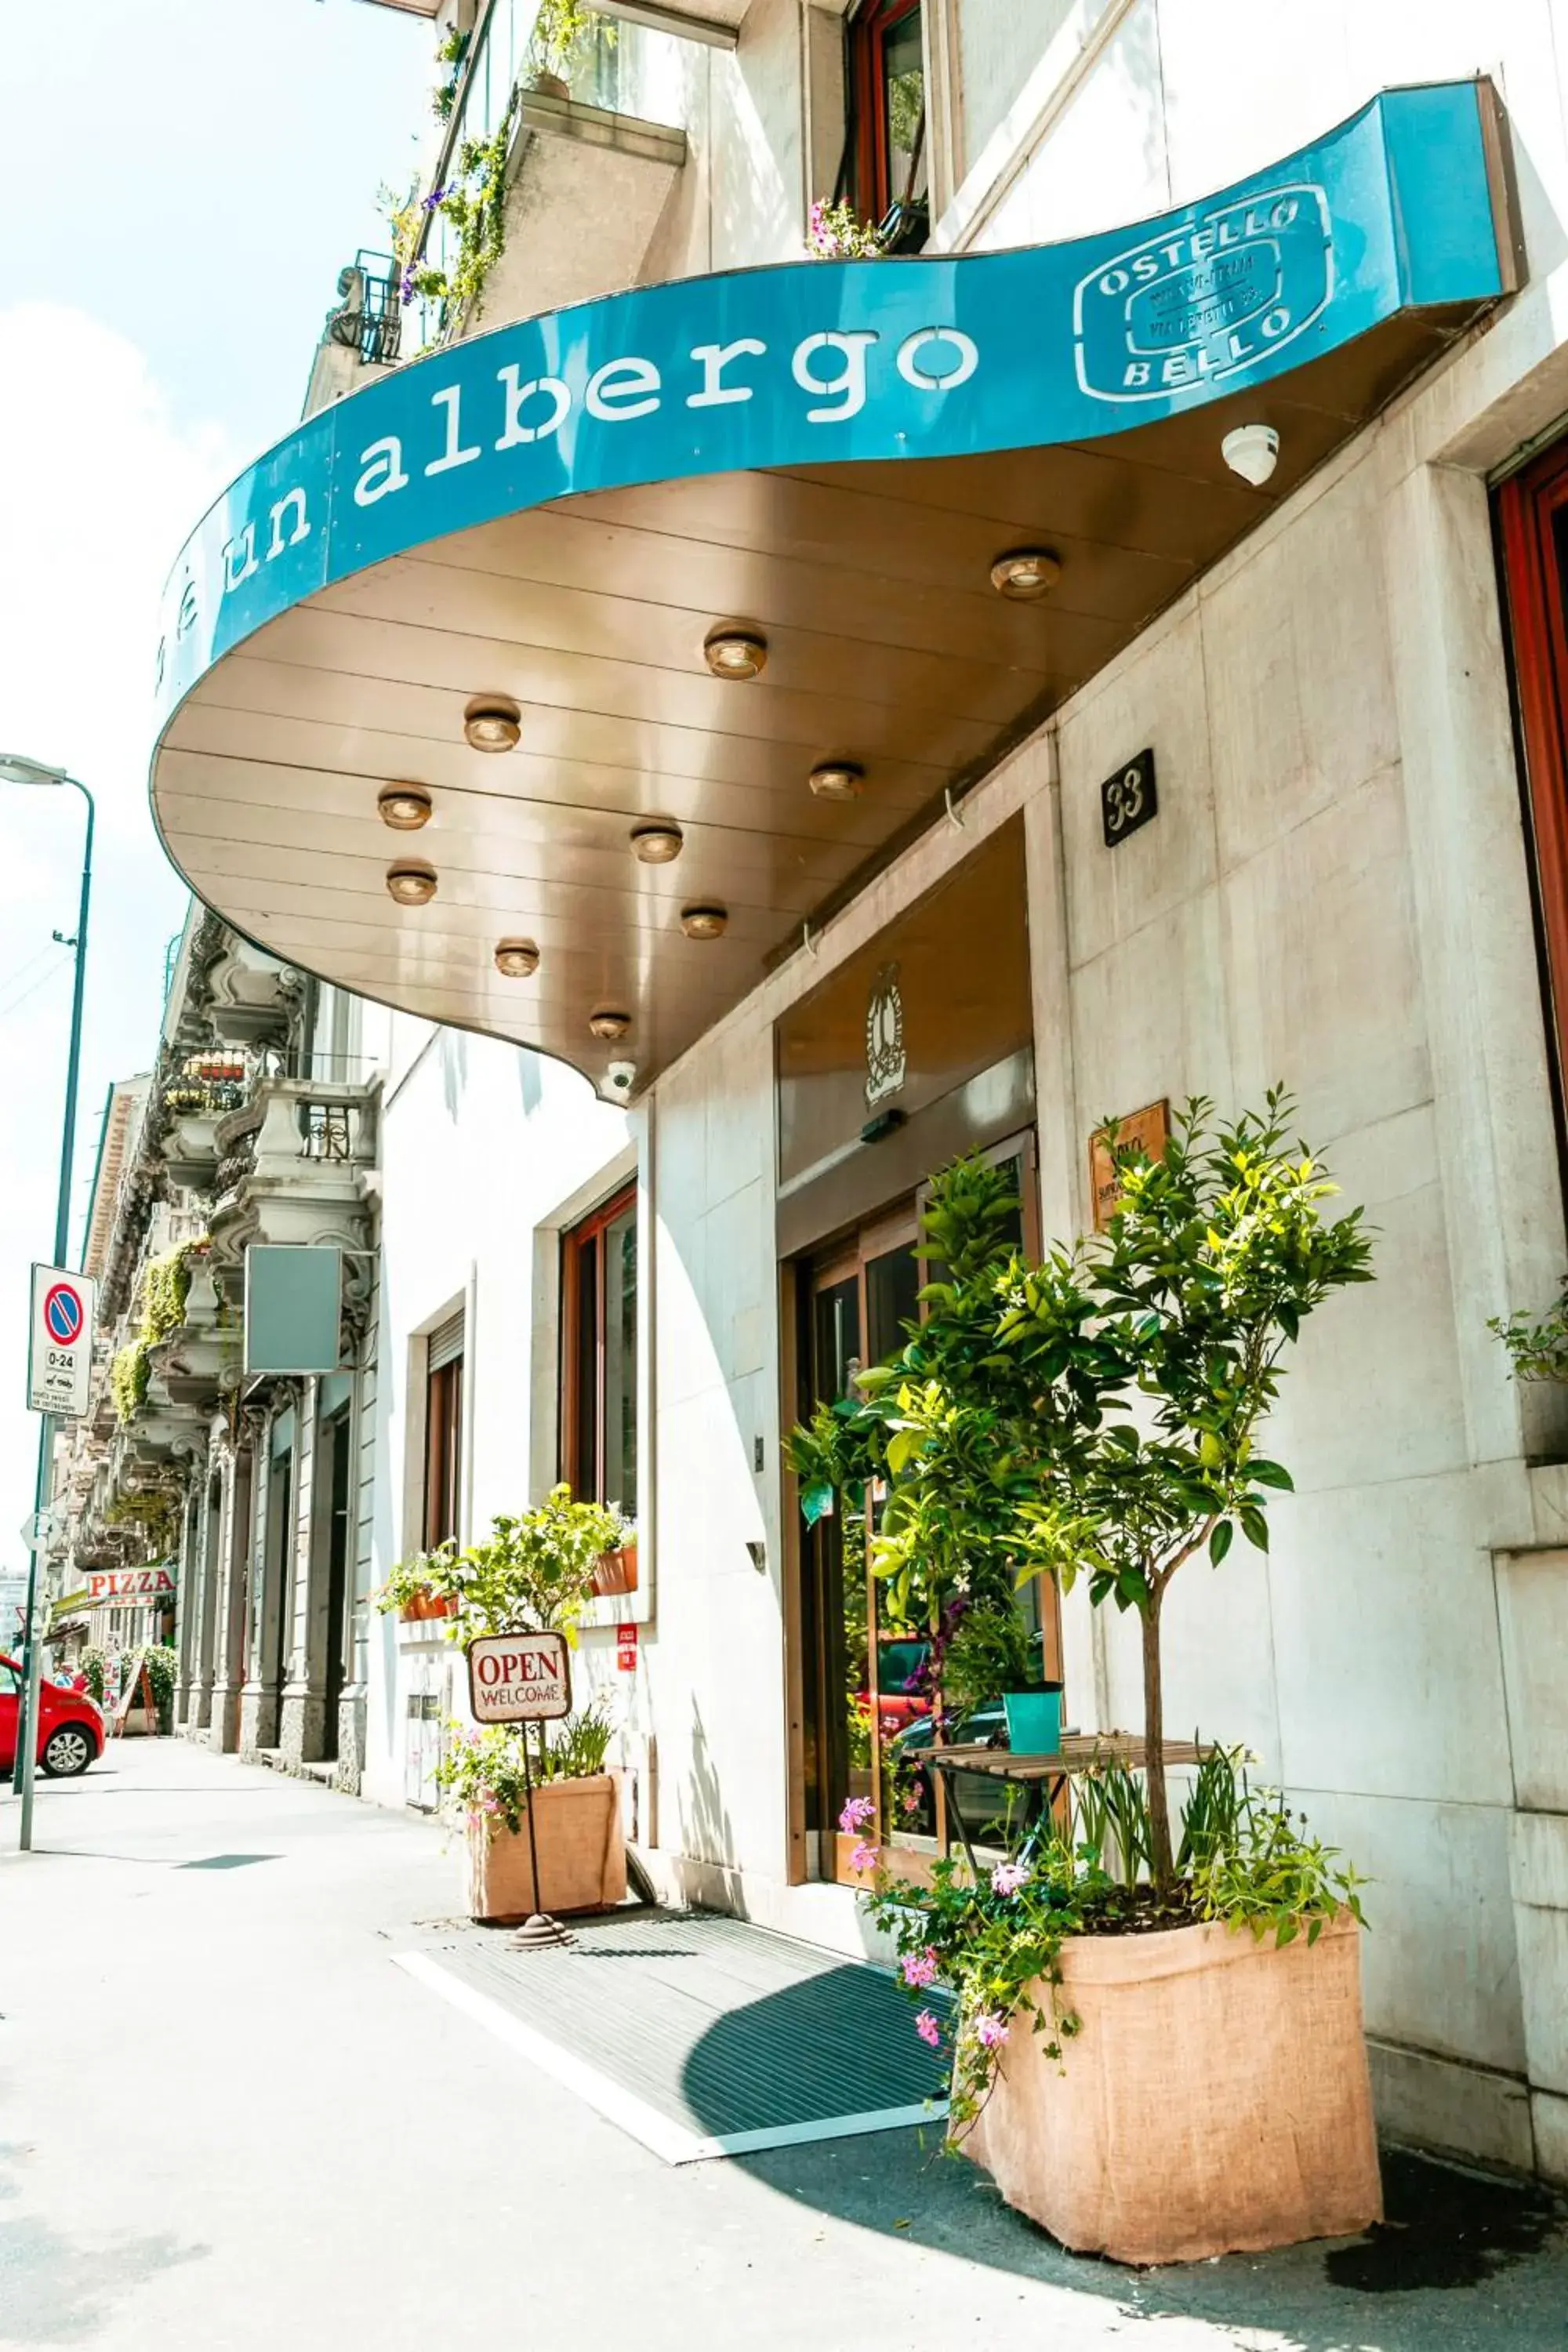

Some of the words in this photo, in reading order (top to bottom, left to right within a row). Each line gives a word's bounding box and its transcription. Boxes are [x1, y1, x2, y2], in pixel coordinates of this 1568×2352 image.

[1098, 197, 1299, 296] OSTELLO
[1123, 307, 1290, 387] BELLO
[220, 485, 312, 593] un
[354, 325, 979, 507] albergo
[1107, 768, 1143, 832] 33
[49, 1352, 73, 1367] 0-24
[89, 1570, 176, 1598] PIZZA
[477, 1650, 560, 1686] OPEN
[481, 1683, 561, 1708] WELCOME
